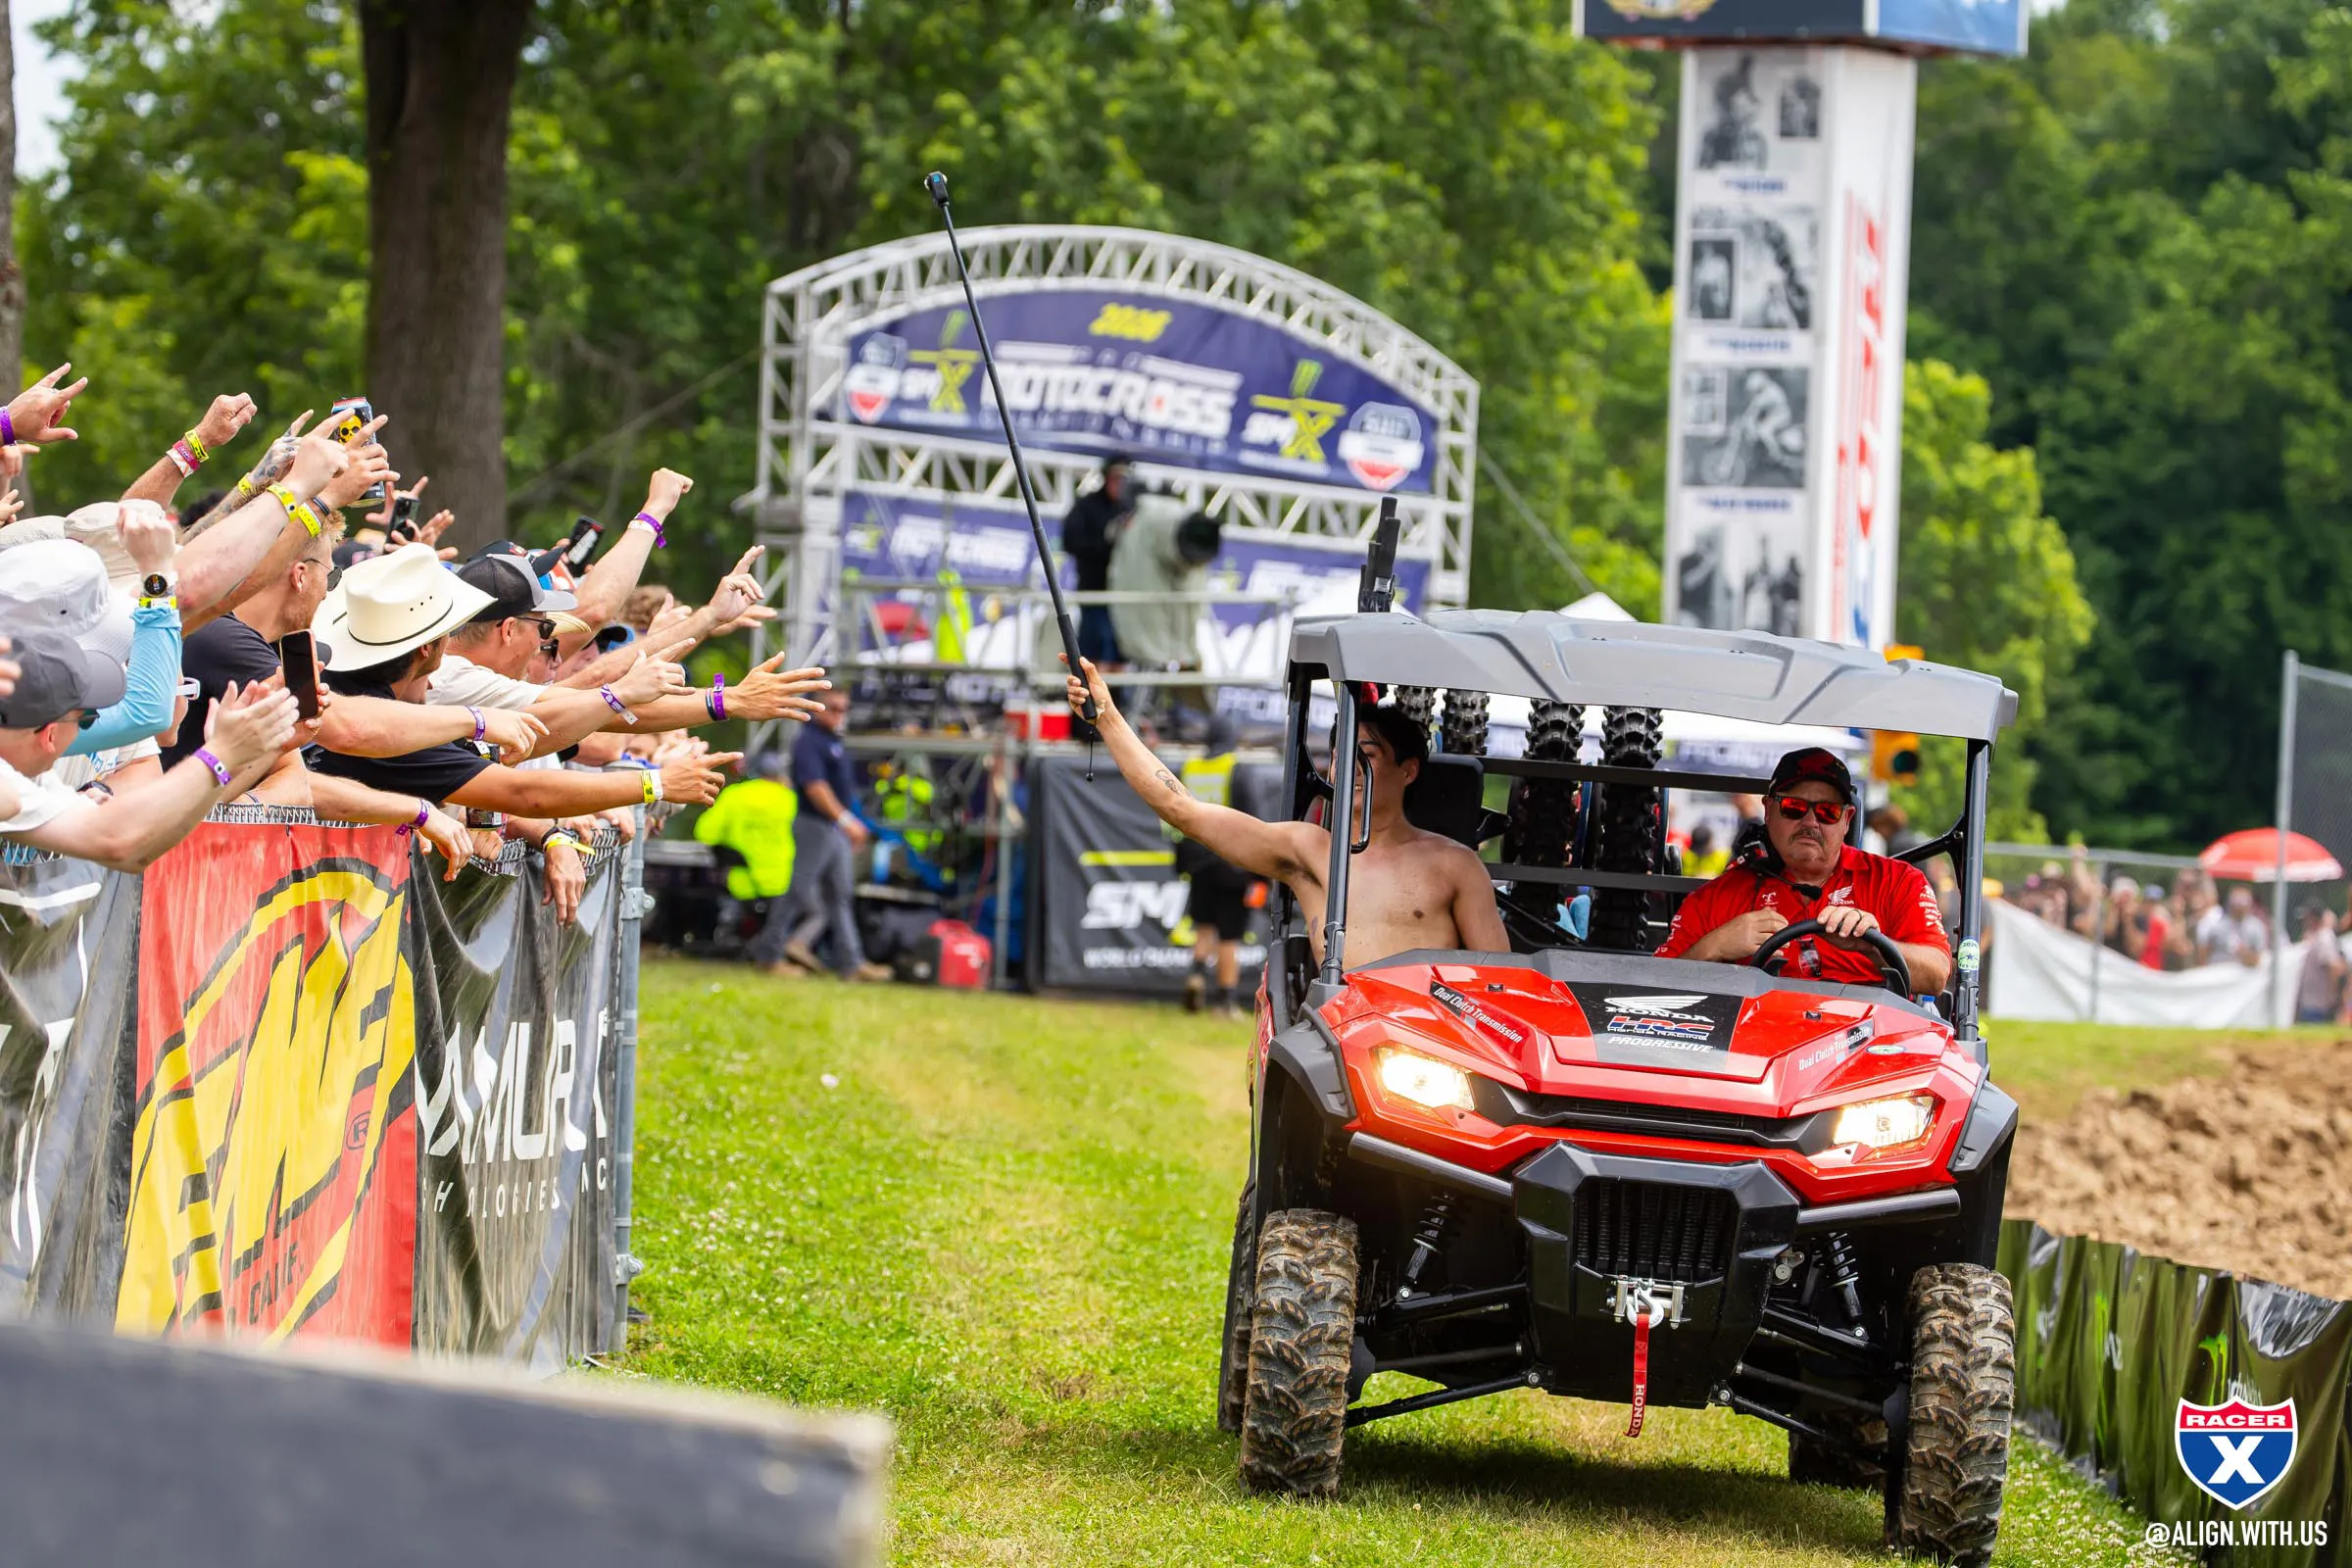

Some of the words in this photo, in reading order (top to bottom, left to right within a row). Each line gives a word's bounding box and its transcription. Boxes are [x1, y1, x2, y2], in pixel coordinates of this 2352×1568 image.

[1081, 881, 1198, 946] SM
[1433, 987, 1451, 1003] Dual
[1450, 996, 1475, 1014] Clutch
[1472, 1007, 1523, 1043] Transmission
[1605, 1006, 1715, 1023] HONDA
[1607, 1015, 1715, 1038] HRC
[1608, 1036, 1714, 1054] PROGRESSIVE
[1798, 1054, 1815, 1071] Dual
[1815, 1045, 1835, 1063] Clutch
[1629, 1383, 1645, 1437] HONDA
